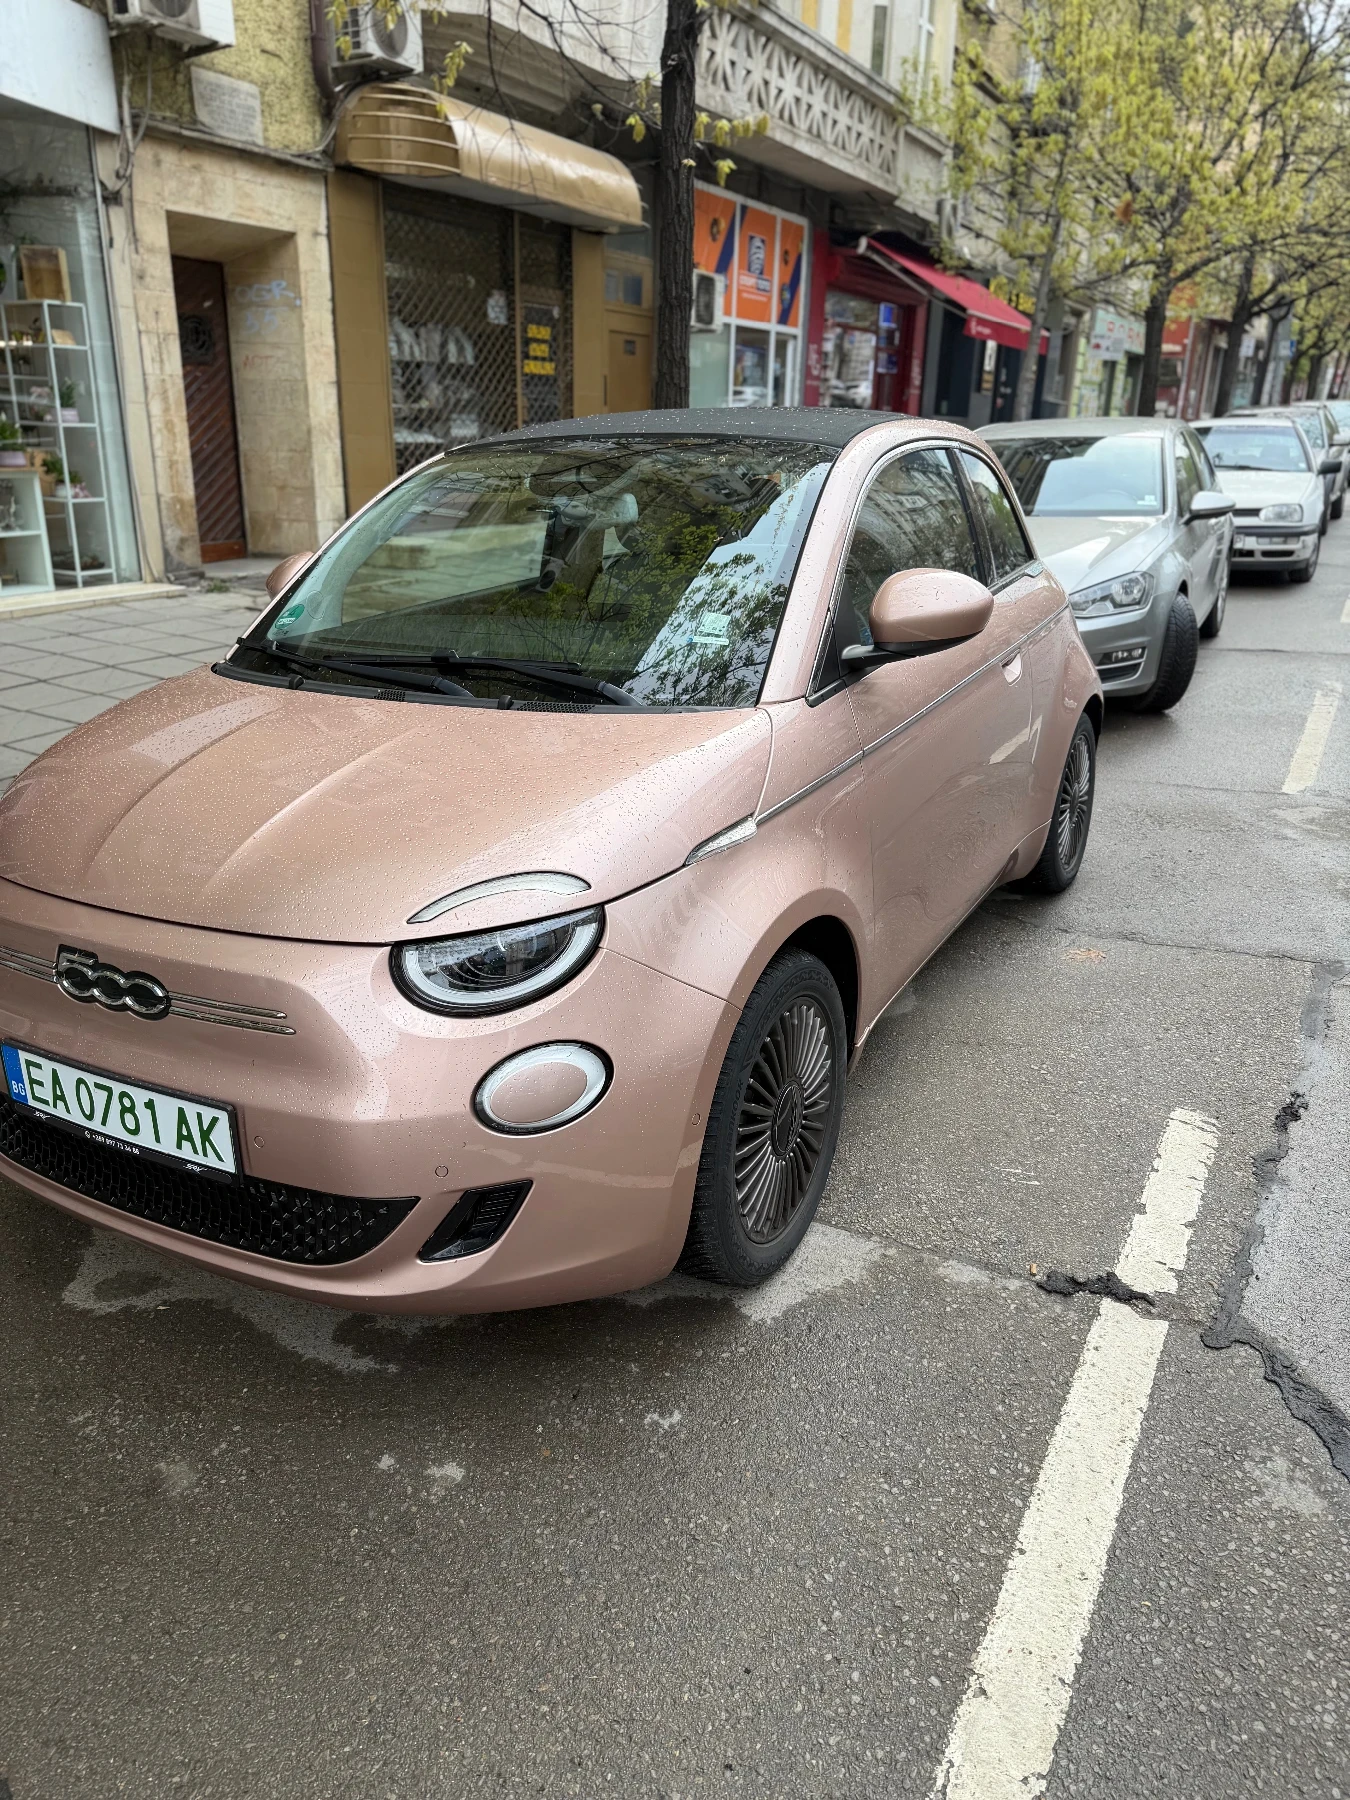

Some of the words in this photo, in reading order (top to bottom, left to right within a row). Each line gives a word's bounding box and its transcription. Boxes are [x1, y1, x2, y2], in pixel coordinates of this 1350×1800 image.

[58, 947, 170, 1017] 500
[12, 1080, 26, 1096] BG
[25, 1059, 71, 1115] EA
[76, 1077, 161, 1144] 0781
[176, 1106, 224, 1162] AK
